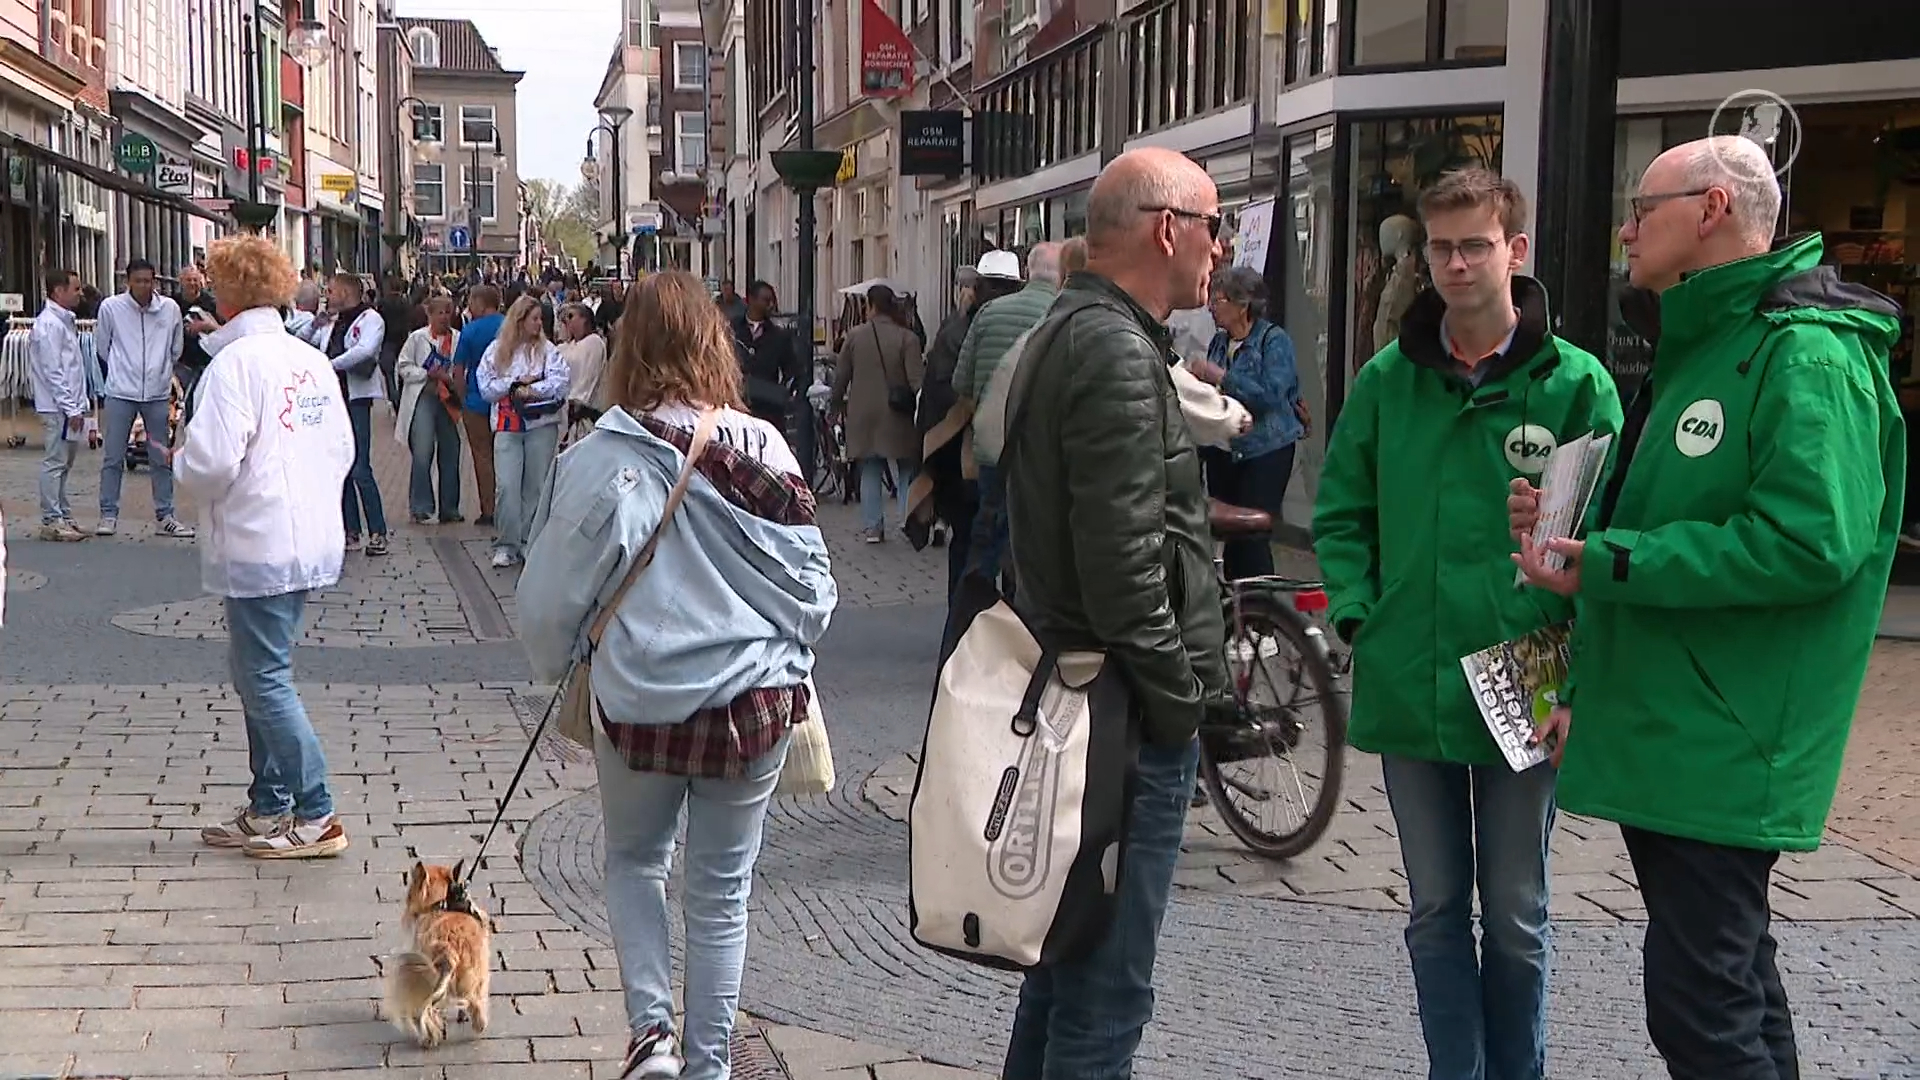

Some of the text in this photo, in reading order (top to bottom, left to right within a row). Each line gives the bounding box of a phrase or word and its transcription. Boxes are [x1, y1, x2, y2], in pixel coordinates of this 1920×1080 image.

[922, 126, 943, 136] GSM
[907, 137, 958, 147] REPARATIE
[159, 167, 189, 186] Etos
[1682, 417, 1718, 440] CDA
[1510, 440, 1551, 458] CDA
[1475, 672, 1531, 770] Samen
